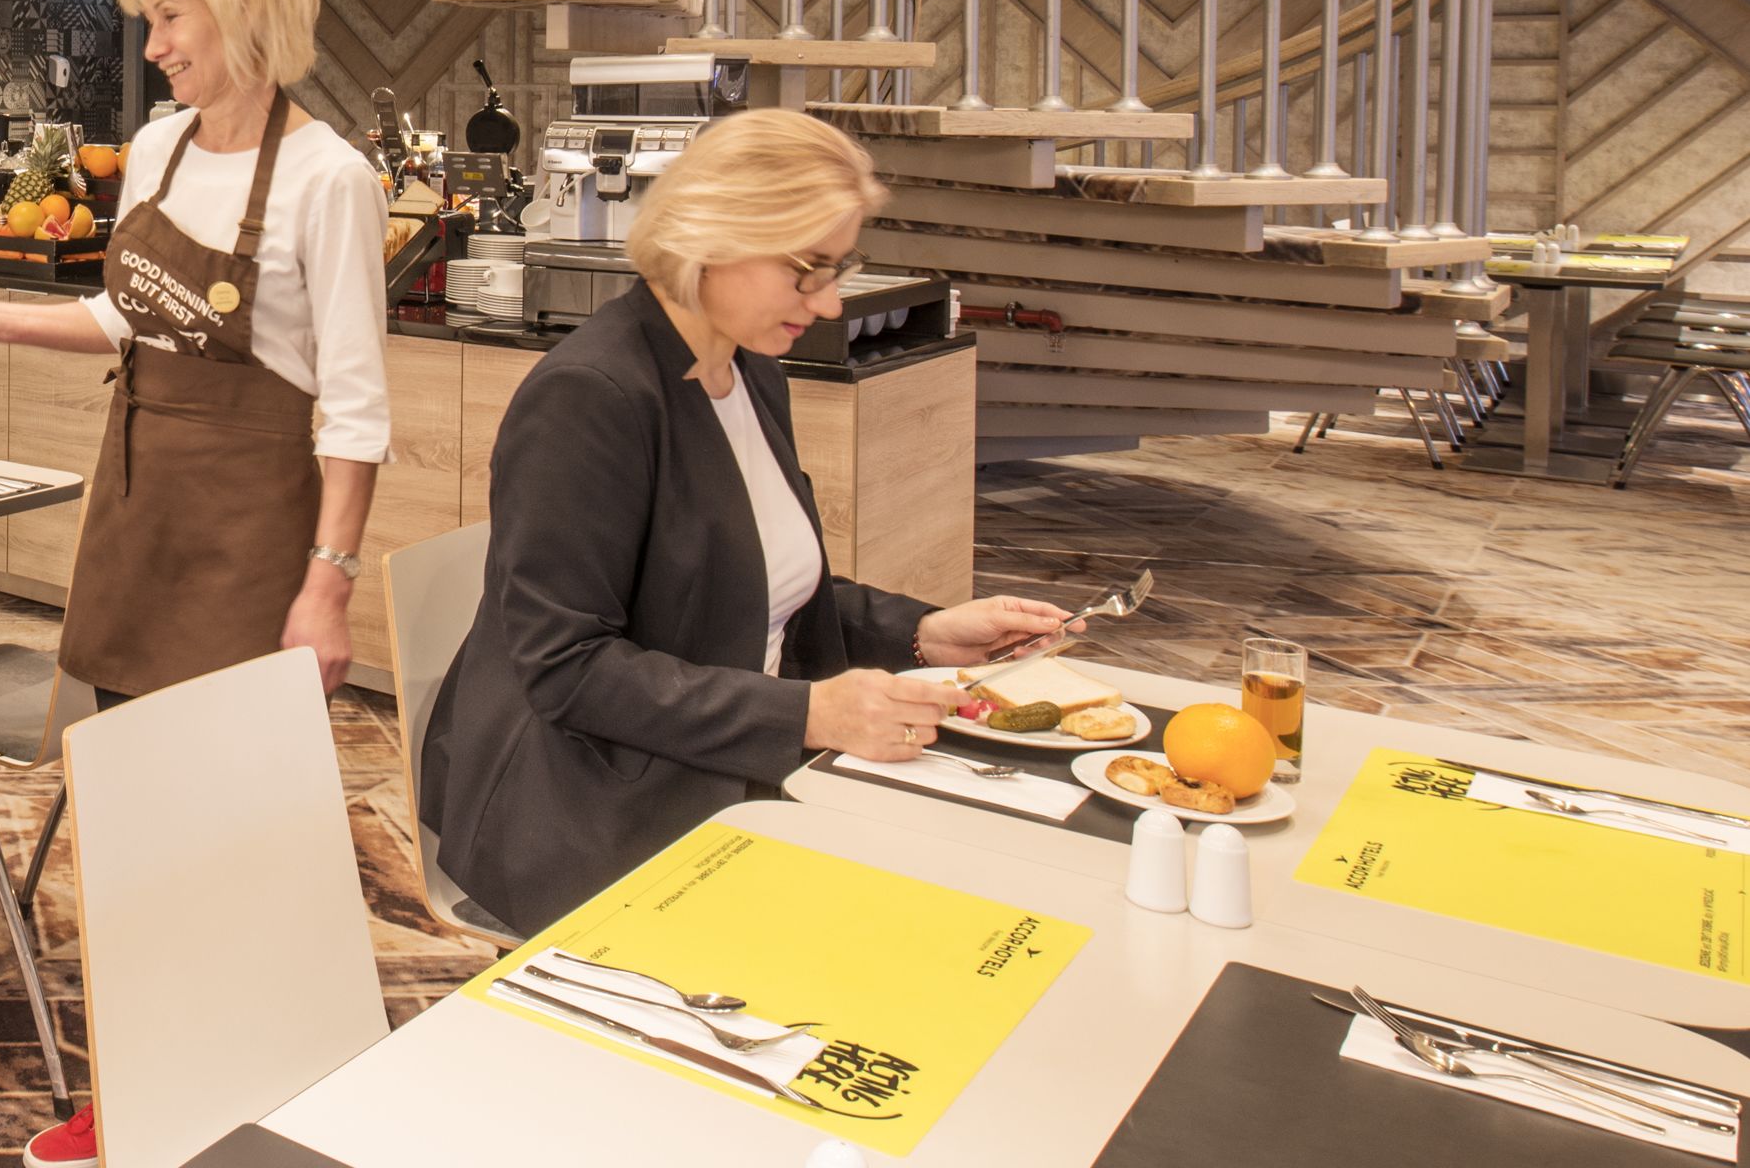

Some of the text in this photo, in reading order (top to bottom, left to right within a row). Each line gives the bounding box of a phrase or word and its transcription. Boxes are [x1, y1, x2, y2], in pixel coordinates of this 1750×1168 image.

[120, 249, 161, 279] GOOD
[160, 271, 224, 328] MORNING,
[130, 273, 161, 298] BUT
[157, 290, 196, 326] FIRST
[976, 915, 1041, 978] ACCORHOTELS
[796, 1039, 877, 1092] HERE
[841, 1051, 920, 1108] ACTING
